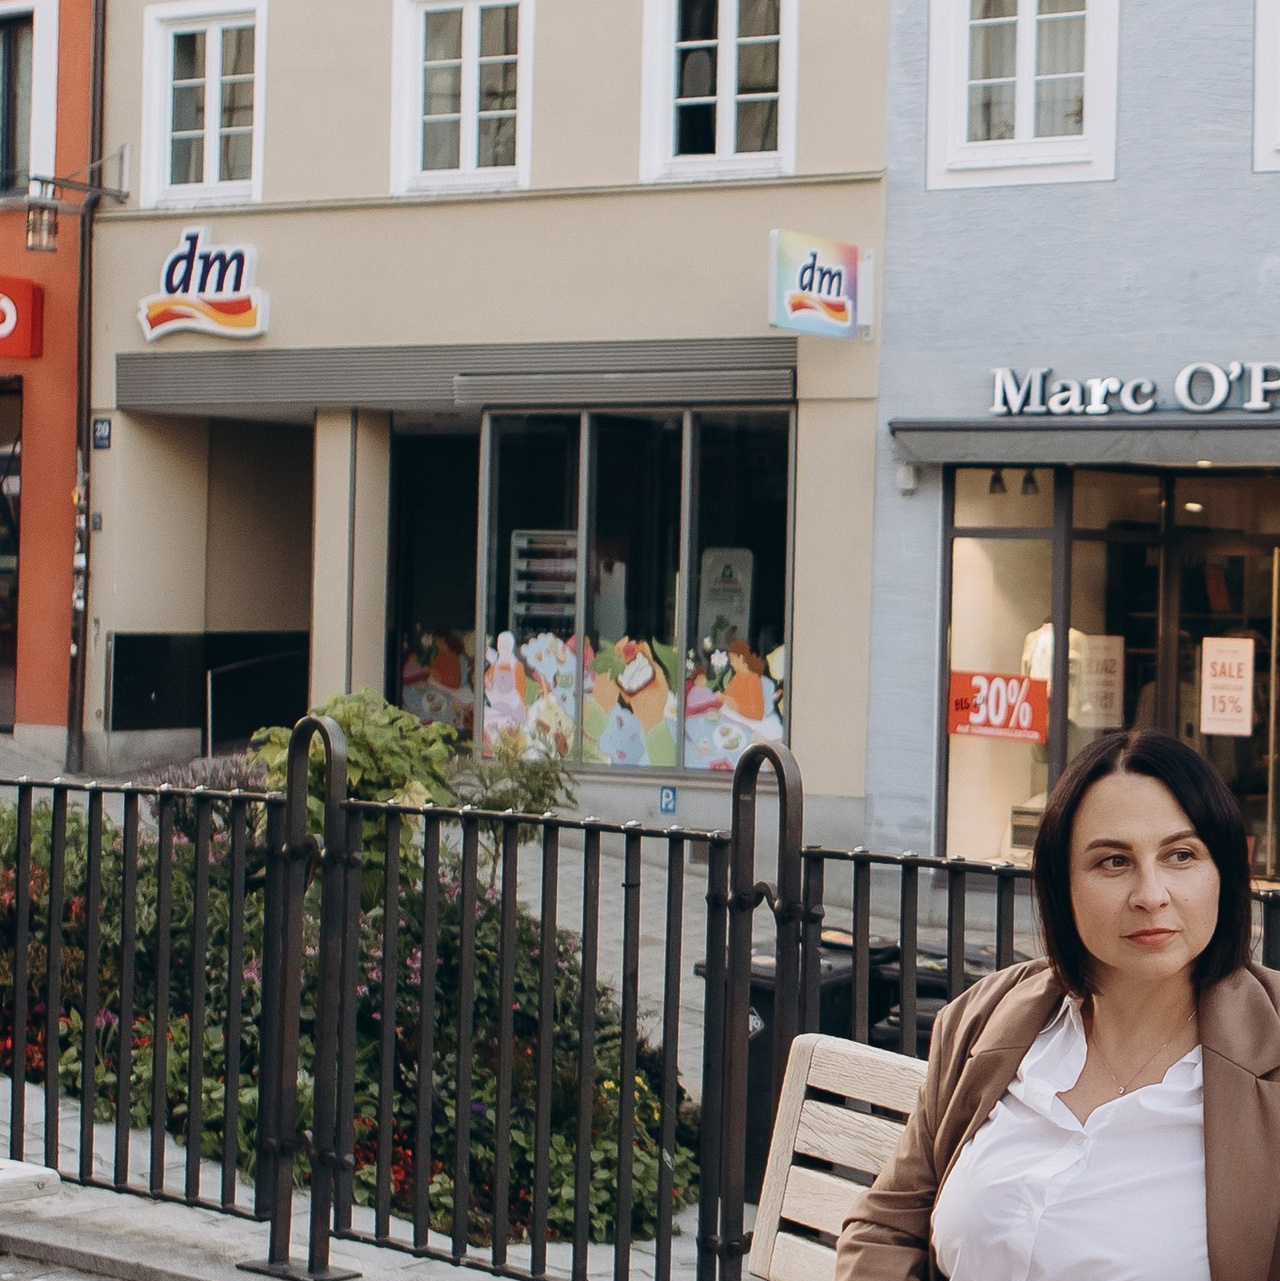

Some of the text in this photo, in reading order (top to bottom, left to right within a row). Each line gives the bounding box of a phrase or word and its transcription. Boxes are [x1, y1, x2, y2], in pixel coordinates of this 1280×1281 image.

[165, 233, 245, 295] dm
[799, 250, 842, 297] dm
[988, 366, 1157, 415] Marc
[1210, 661, 1245, 679] SALE
[1210, 695, 1244, 714] 15%
